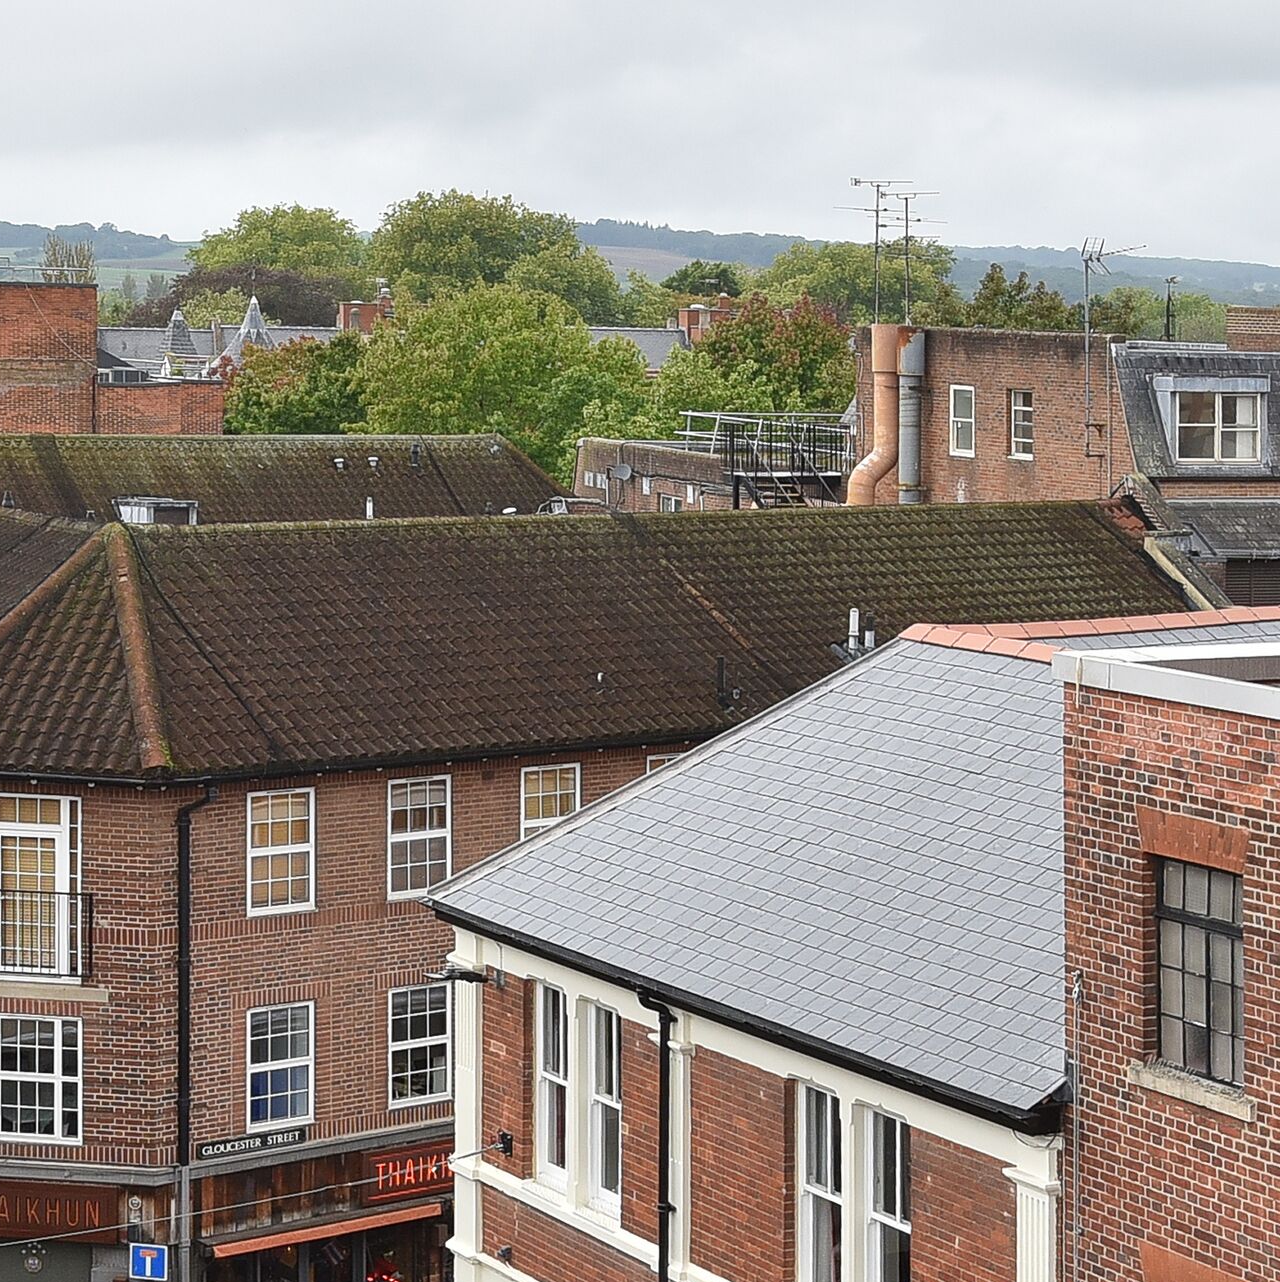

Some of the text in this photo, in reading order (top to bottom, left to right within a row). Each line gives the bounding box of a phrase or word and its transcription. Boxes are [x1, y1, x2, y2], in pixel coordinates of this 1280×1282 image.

[201, 1130, 300, 1157] GLOUCESTER STREET
[375, 1152, 453, 1190] THAIKH
